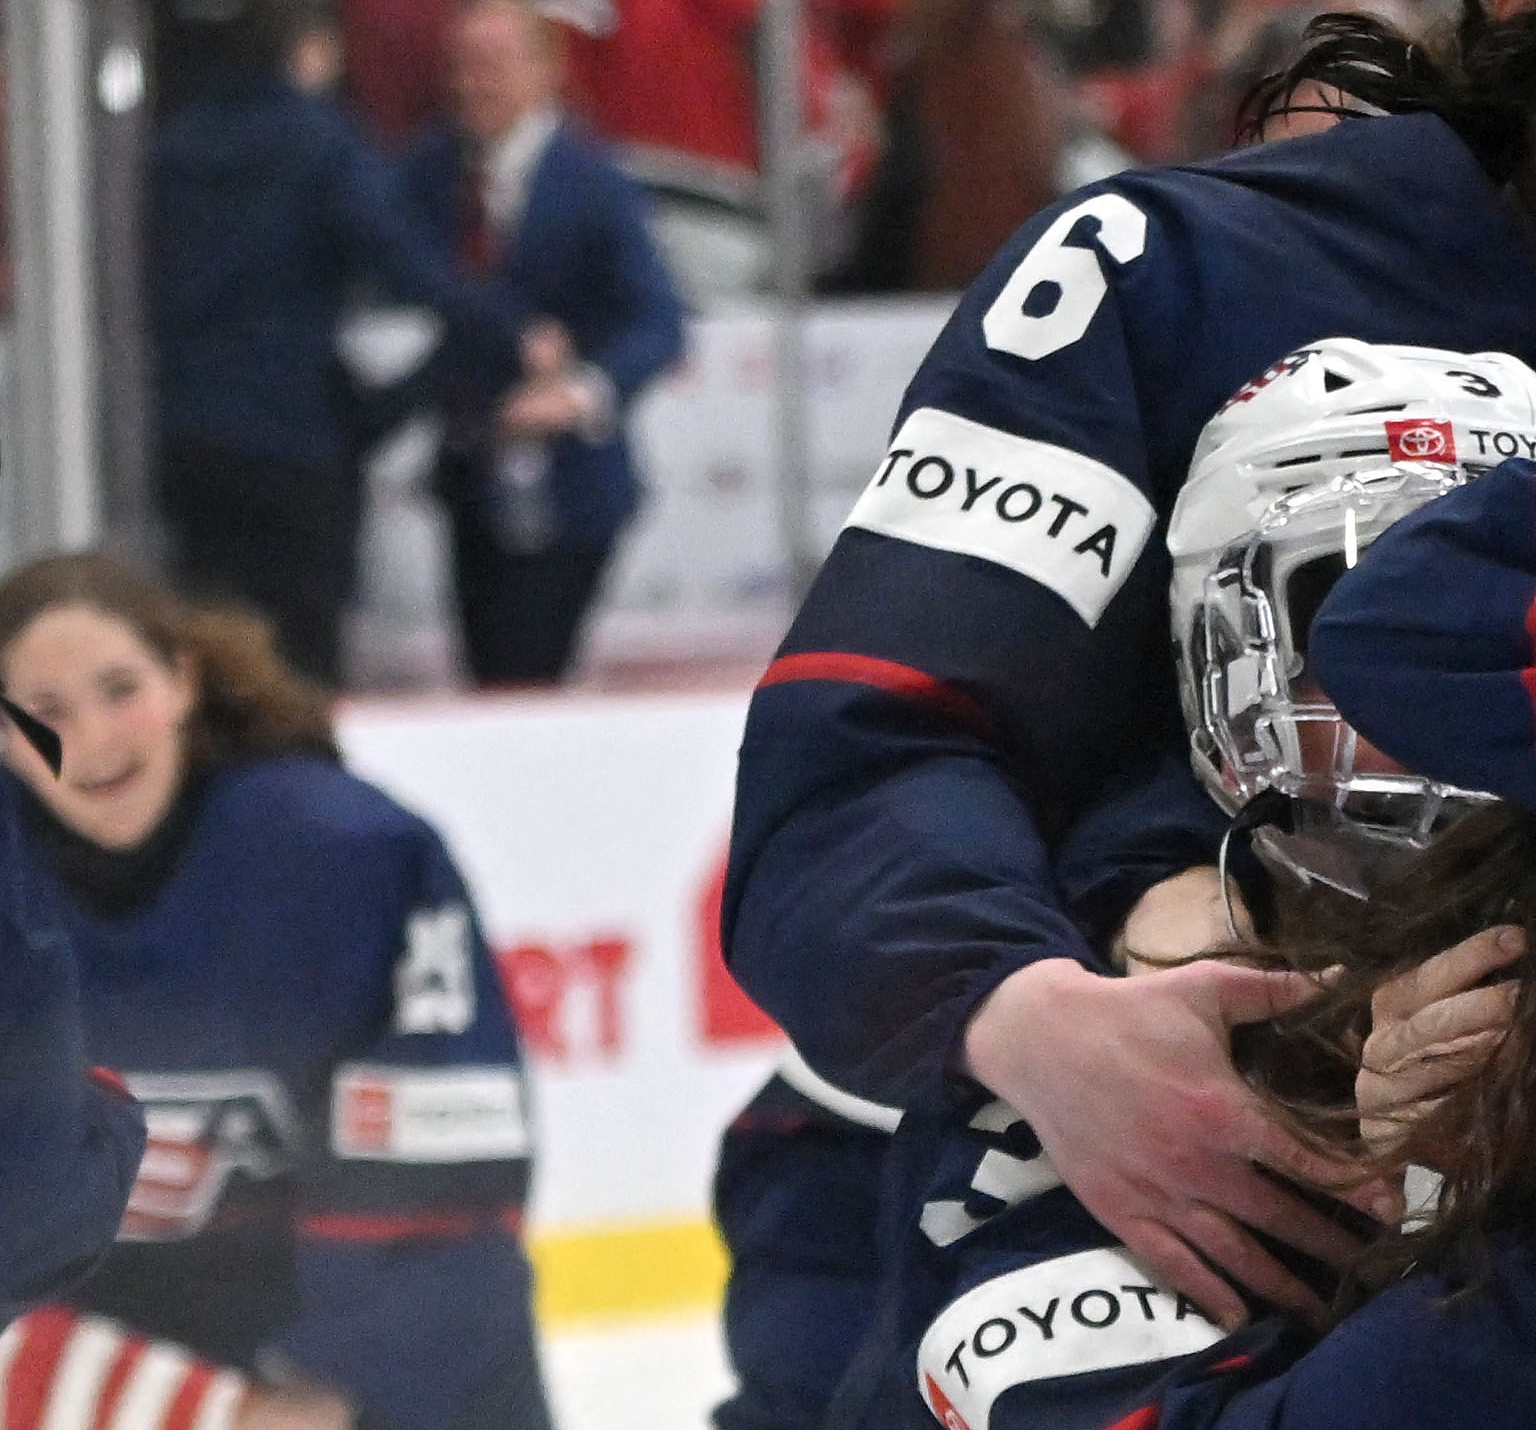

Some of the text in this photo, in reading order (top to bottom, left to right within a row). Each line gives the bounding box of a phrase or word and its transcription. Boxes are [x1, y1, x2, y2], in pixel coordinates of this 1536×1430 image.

[983, 193, 1147, 361] 6
[1446, 370, 1501, 399] 3
[877, 449, 1119, 579] TOYOTA
